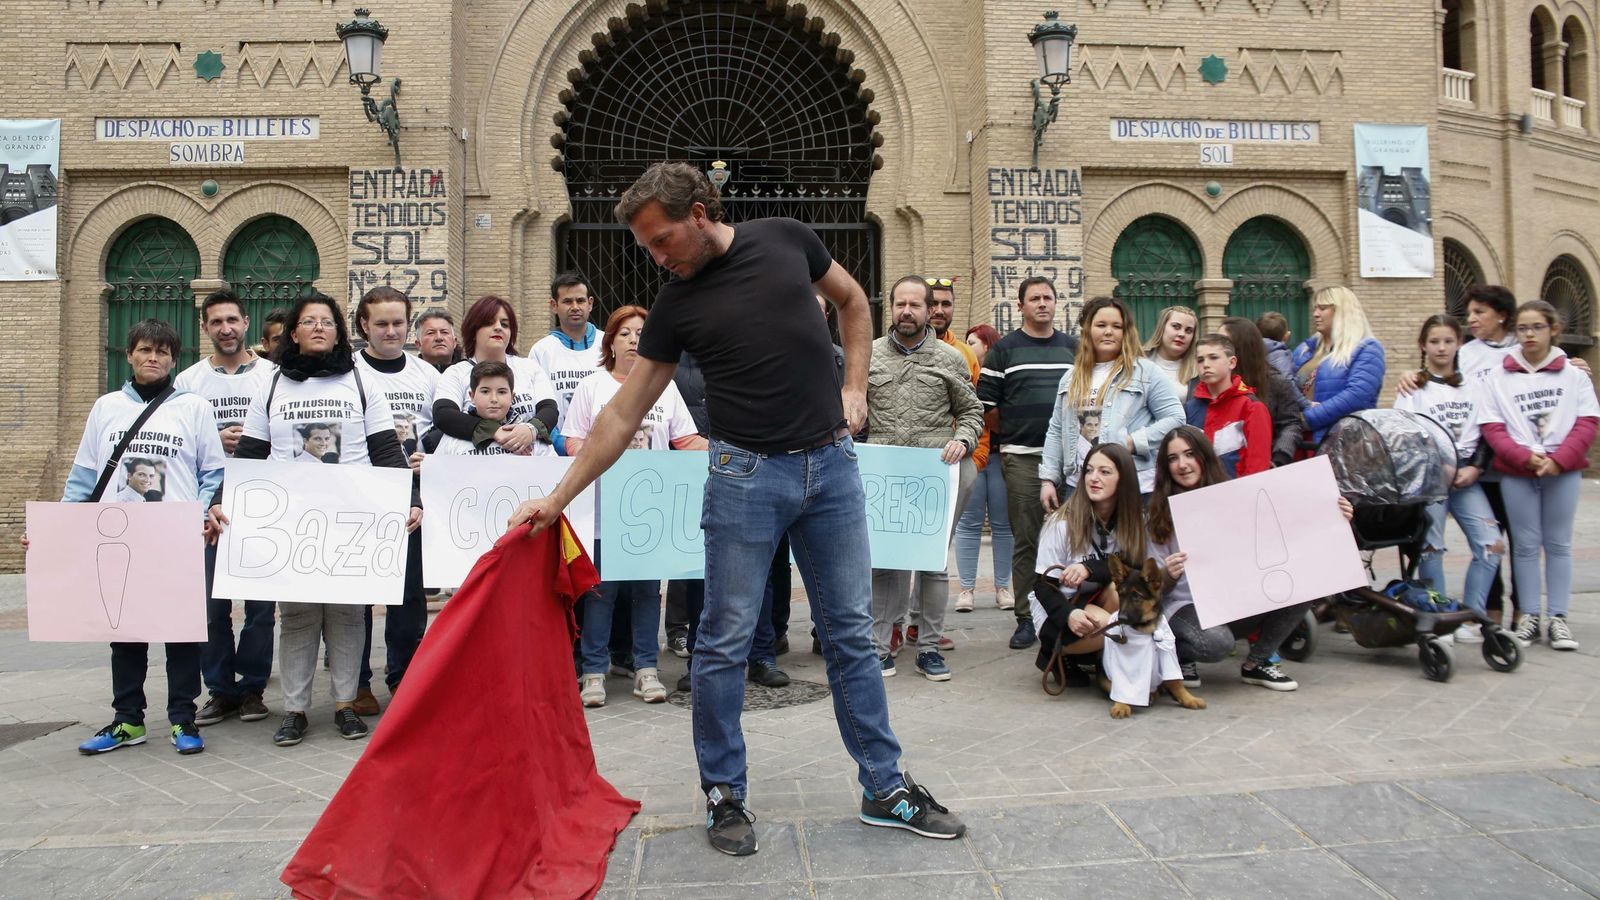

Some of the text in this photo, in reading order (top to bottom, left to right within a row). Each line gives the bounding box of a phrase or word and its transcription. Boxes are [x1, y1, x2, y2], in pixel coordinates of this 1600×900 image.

[104, 118, 311, 138] DESPACHO DE BILLETES
[1117, 120, 1311, 140] DESPACHO DE BILLETES
[170, 144, 244, 163] SOMBRA
[1202, 147, 1232, 163] SOL
[350, 169, 446, 199] ENTRADA
[988, 168, 1082, 196] ENTRADA
[352, 202, 446, 227] TENDIDOS
[991, 200, 1082, 225] TENDIDOS
[351, 231, 445, 265] SOL
[991, 228, 1081, 261] SOL
[557, 370, 567, 379] TU
[568, 370, 596, 379] ILUSIO
[556, 382, 564, 391] LA
[288, 401, 300, 410] TU
[302, 399, 341, 408] ILUSION
[416, 393, 424, 401] ES
[522, 393, 532, 401] ES
[296, 410, 343, 420] NUESTRA
[135, 431, 171, 443] LUSION
[172, 436, 184, 447] ES
[126, 443, 169, 457] NUESTRA
[227, 478, 406, 578] Baza
